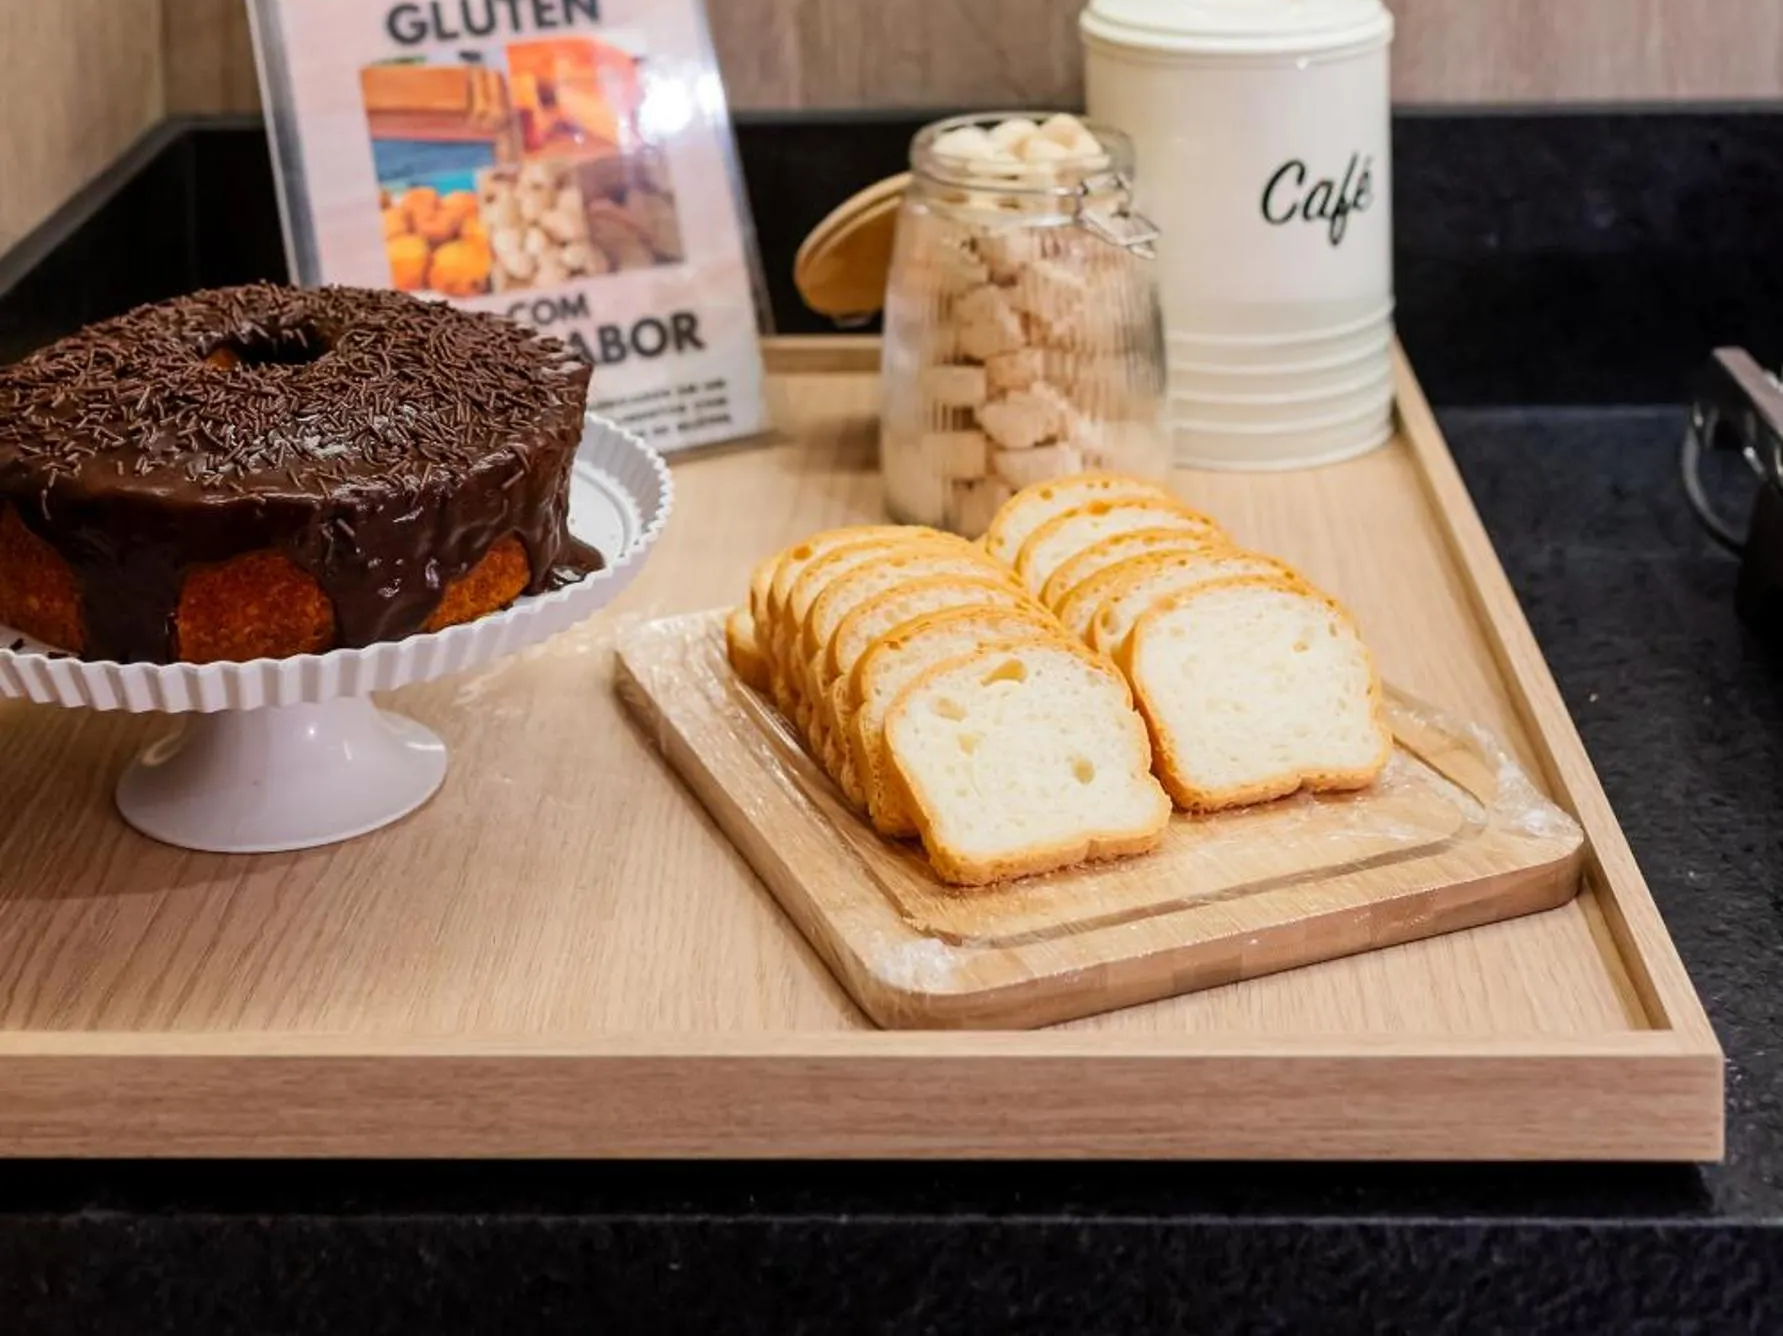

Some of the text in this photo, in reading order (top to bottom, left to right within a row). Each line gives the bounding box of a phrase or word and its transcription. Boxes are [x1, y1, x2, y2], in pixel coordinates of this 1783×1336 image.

[1261, 153, 1372, 246] Café
[508, 293, 589, 326] COM
[566, 309, 705, 364] ABOR
